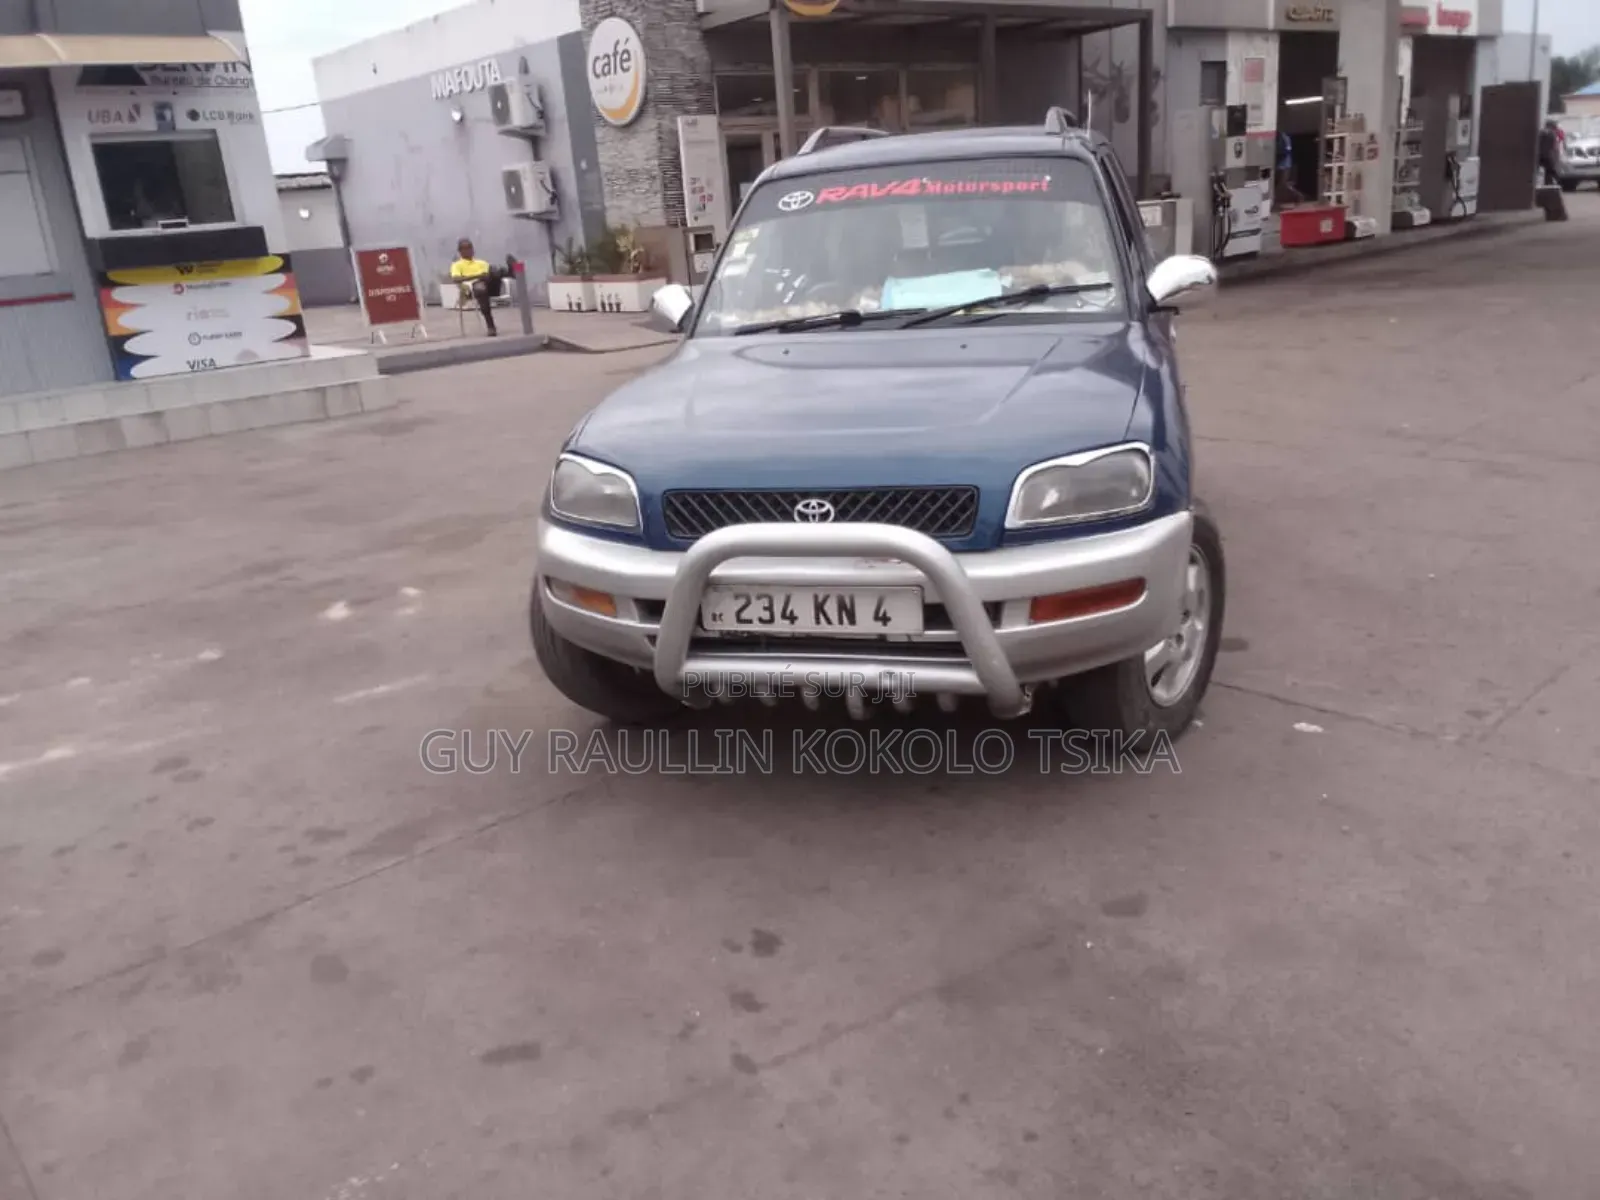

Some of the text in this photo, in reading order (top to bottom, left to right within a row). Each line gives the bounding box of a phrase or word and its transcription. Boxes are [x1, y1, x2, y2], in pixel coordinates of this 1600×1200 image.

[592, 37, 631, 78] café
[429, 59, 501, 100] MAFOUTA
[87, 108, 123, 124] UBA
[815, 177, 1050, 205] RAV4 Motorsport
[186, 357, 217, 371] VISA
[735, 594, 799, 625] 234
[813, 593, 858, 626] KN
[873, 595, 892, 627] 4
